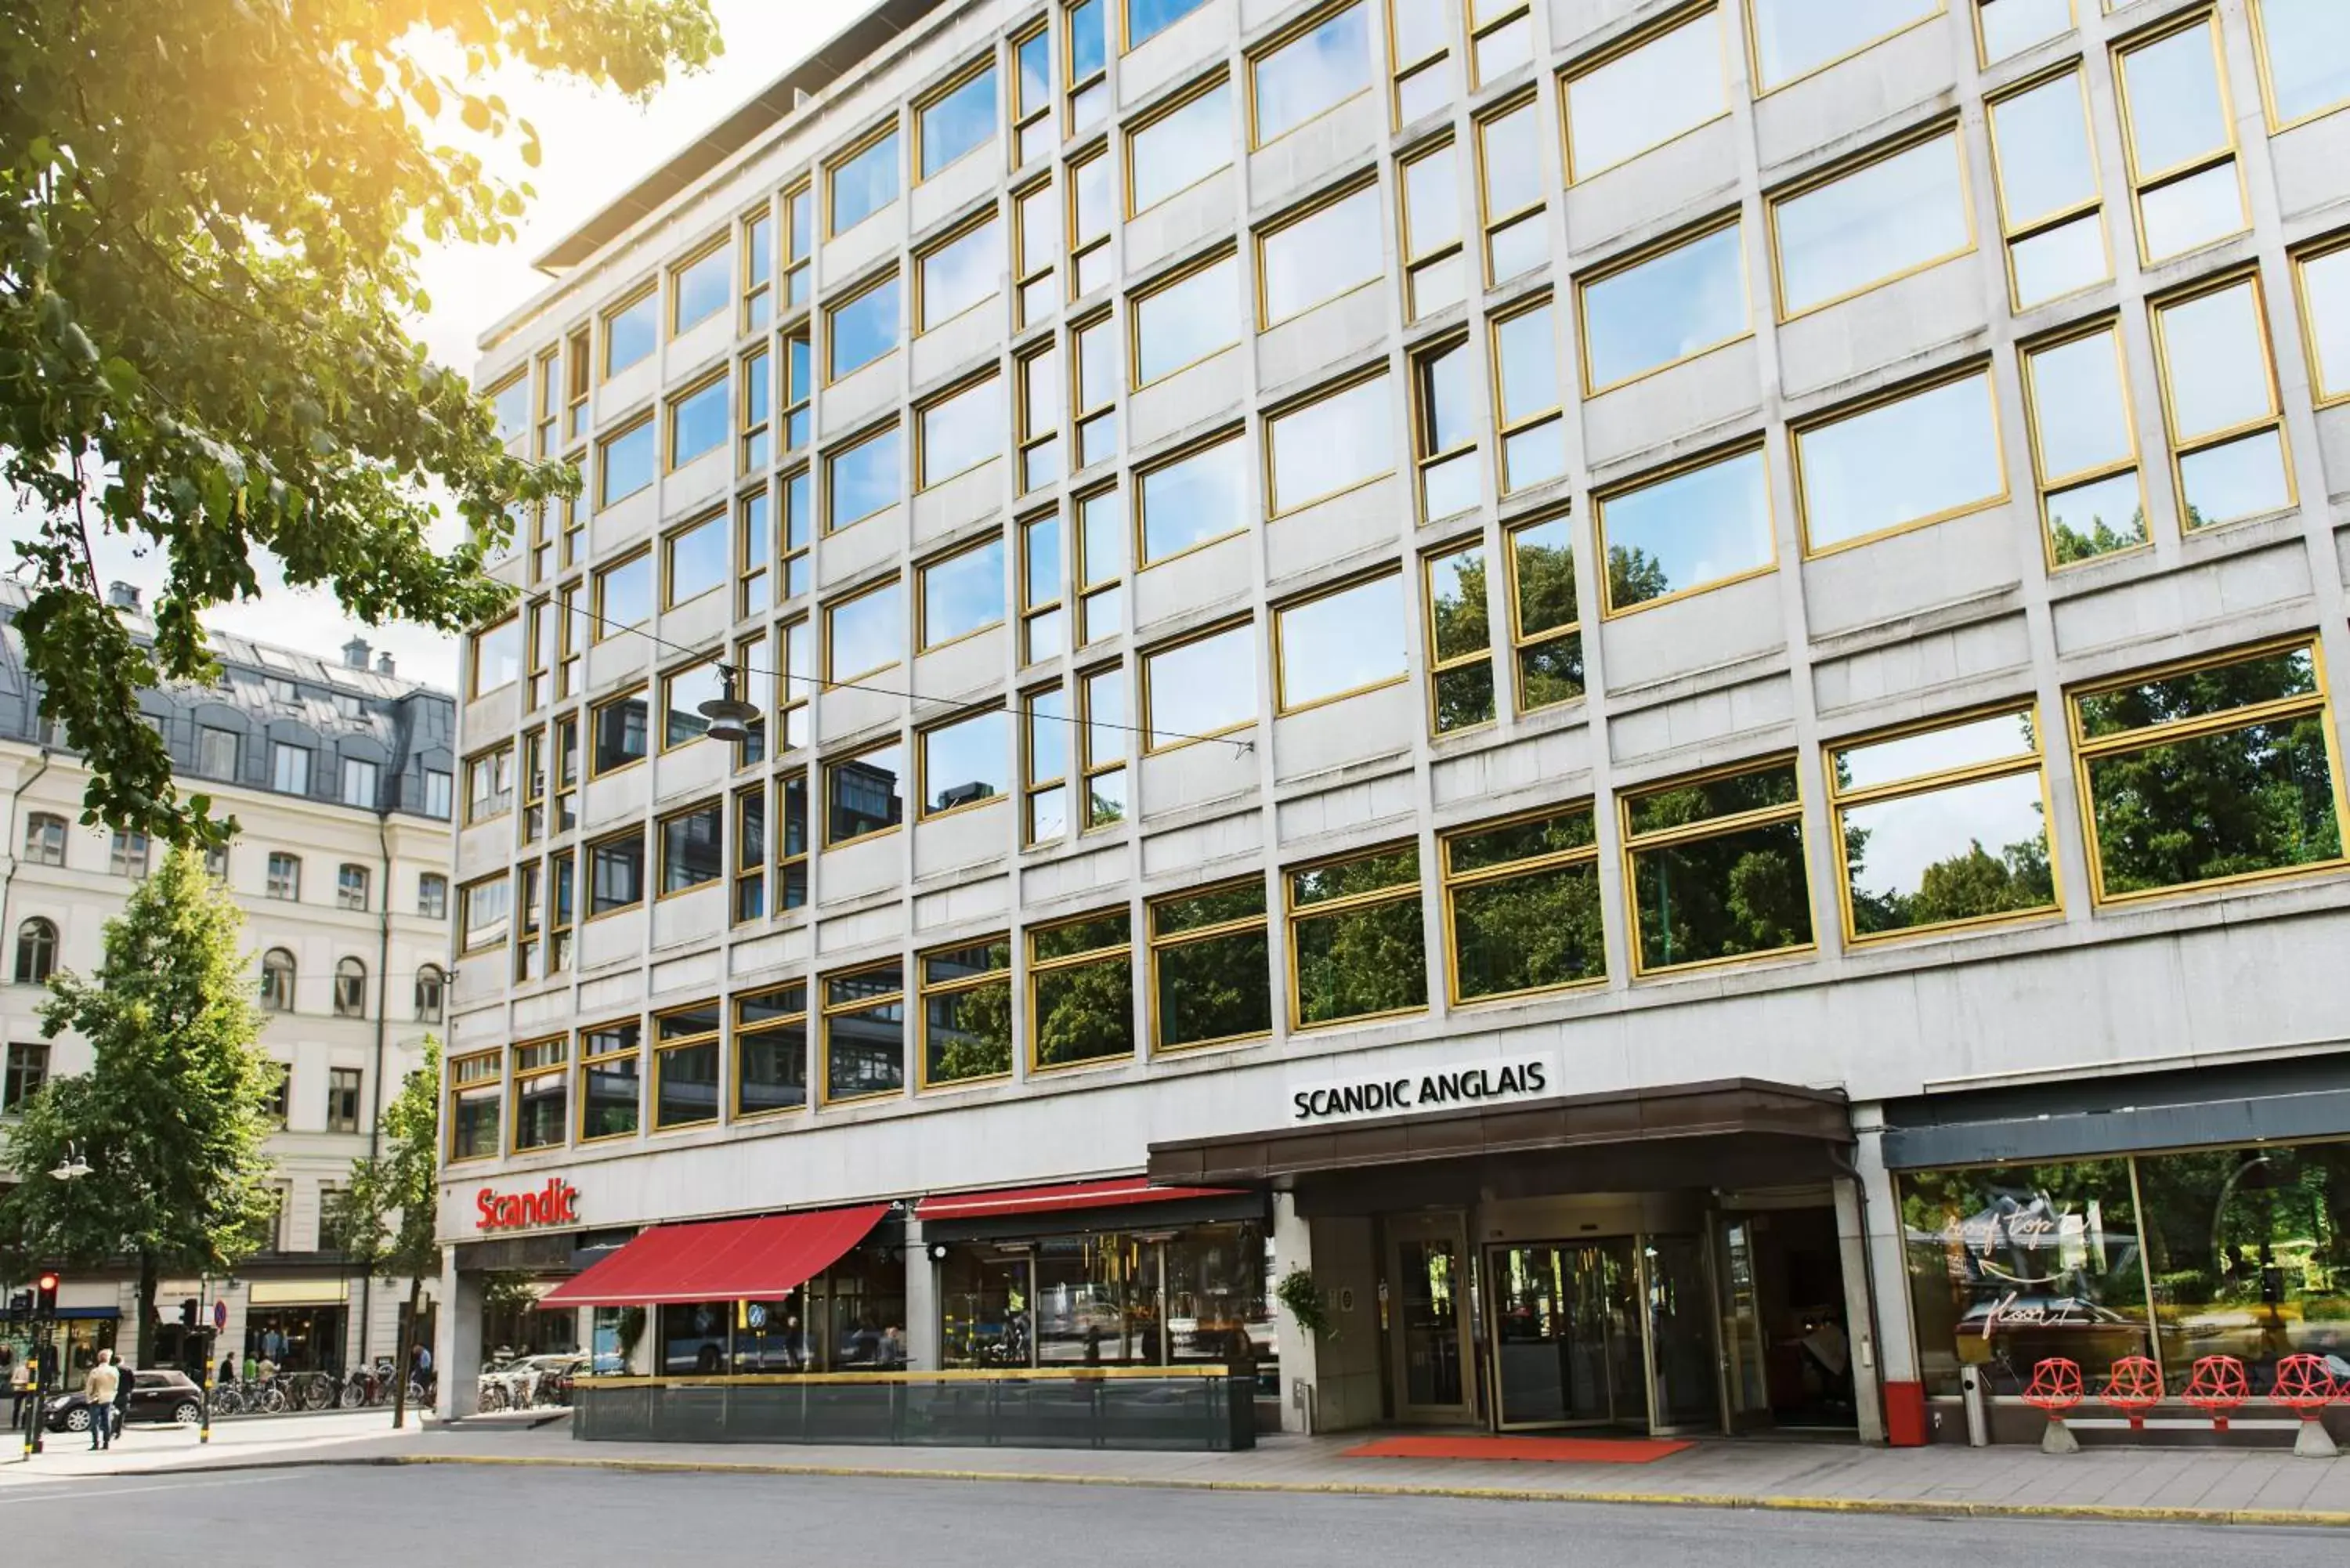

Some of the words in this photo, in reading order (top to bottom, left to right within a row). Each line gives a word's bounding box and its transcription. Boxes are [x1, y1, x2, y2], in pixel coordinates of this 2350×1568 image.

[1293, 1078, 1411, 1118] SCANDIC
[1418, 1061, 1546, 1104] ANGLAIS
[476, 1177, 577, 1229] Scandic
[2003, 1204, 2055, 1251] top
[1982, 1291, 2058, 1340] floor
